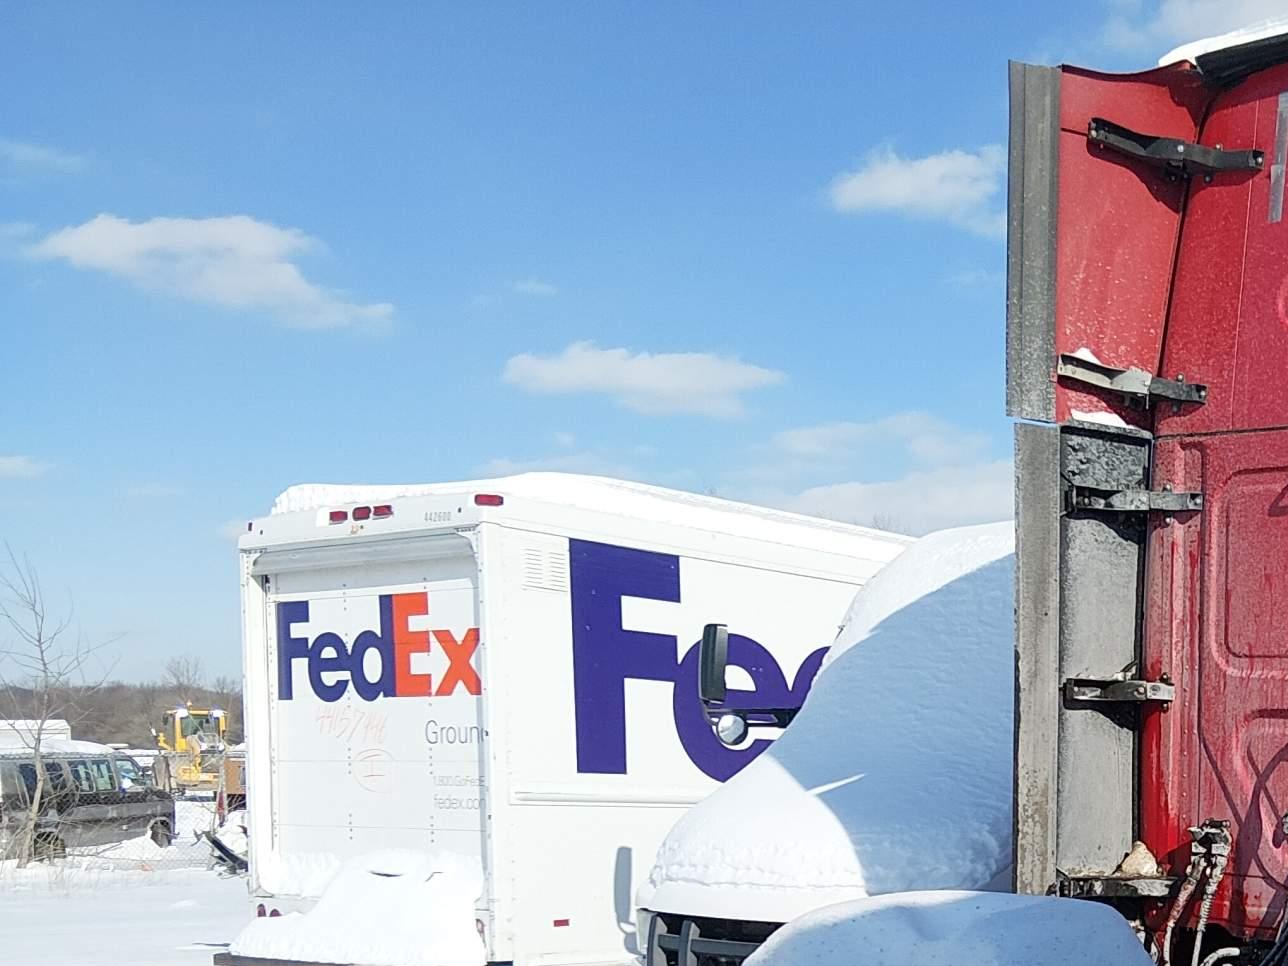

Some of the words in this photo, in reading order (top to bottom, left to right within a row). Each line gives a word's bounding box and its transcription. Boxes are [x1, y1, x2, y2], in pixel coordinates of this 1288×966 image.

[277, 591, 481, 702] FedEx
[568, 537, 833, 783] Fe
[425, 719, 485, 745] Groun
